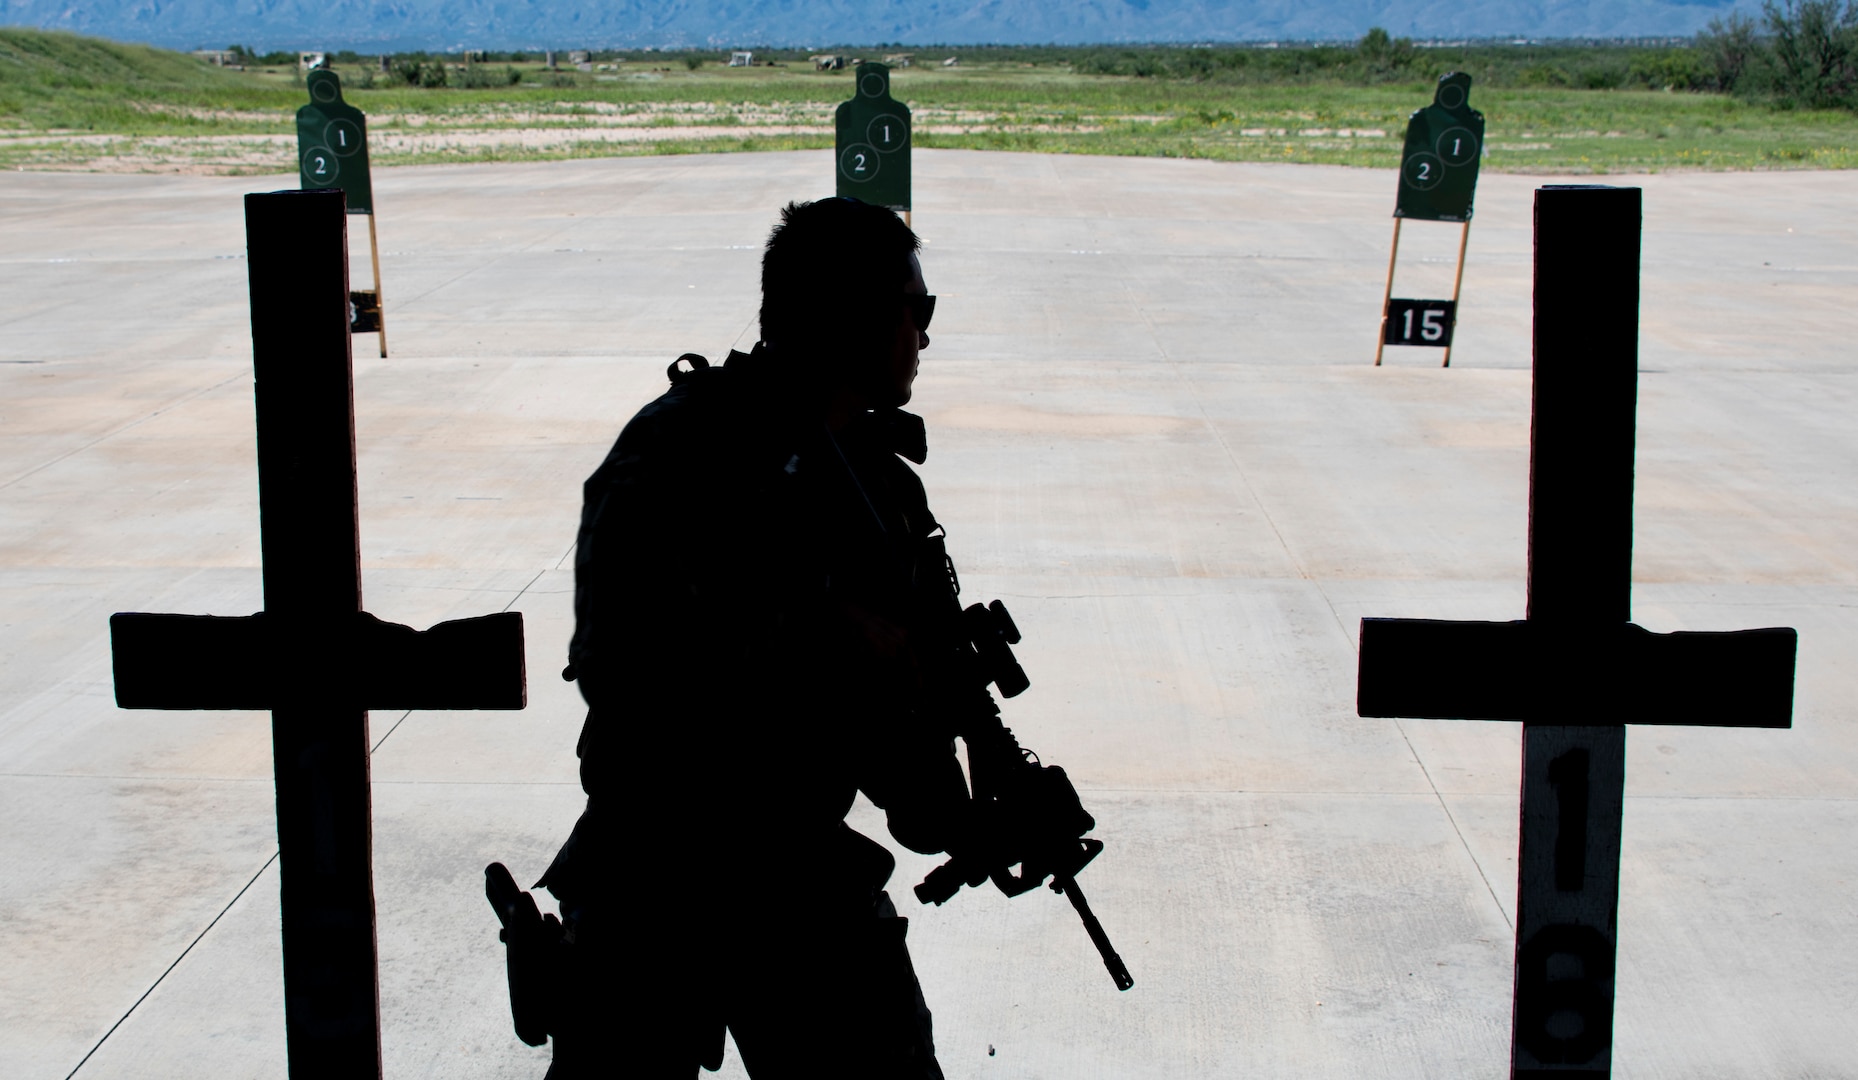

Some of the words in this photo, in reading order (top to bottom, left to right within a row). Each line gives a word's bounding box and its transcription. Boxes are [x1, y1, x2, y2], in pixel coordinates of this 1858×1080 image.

[338, 129, 347, 147] 1
[884, 125, 891, 143] 1
[1452, 138, 1461, 157] 1
[314, 157, 327, 174] 2
[854, 153, 866, 171] 2
[1417, 162, 1431, 180] 2
[1402, 308, 1446, 342] 15
[1516, 748, 1614, 1065] 16
